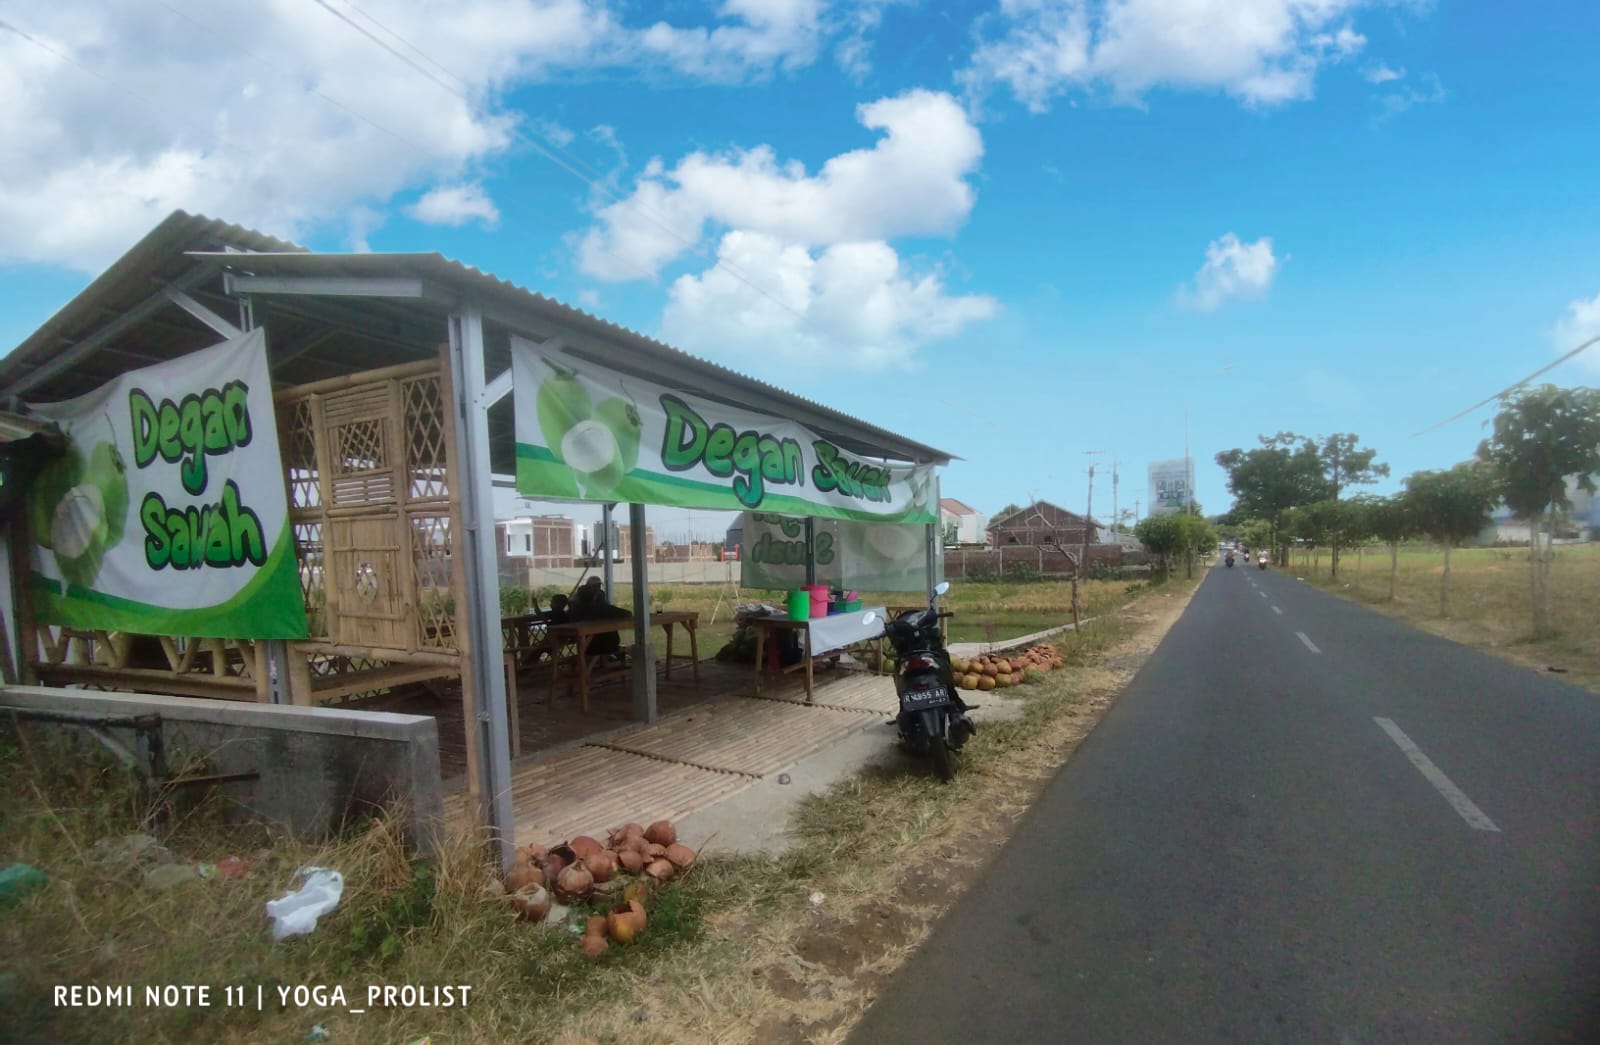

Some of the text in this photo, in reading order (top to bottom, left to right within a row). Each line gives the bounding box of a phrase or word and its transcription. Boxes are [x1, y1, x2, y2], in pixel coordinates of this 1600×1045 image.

[129, 379, 252, 495] Degan
[660, 393, 805, 509] Degan
[140, 478, 268, 570] Sawah
